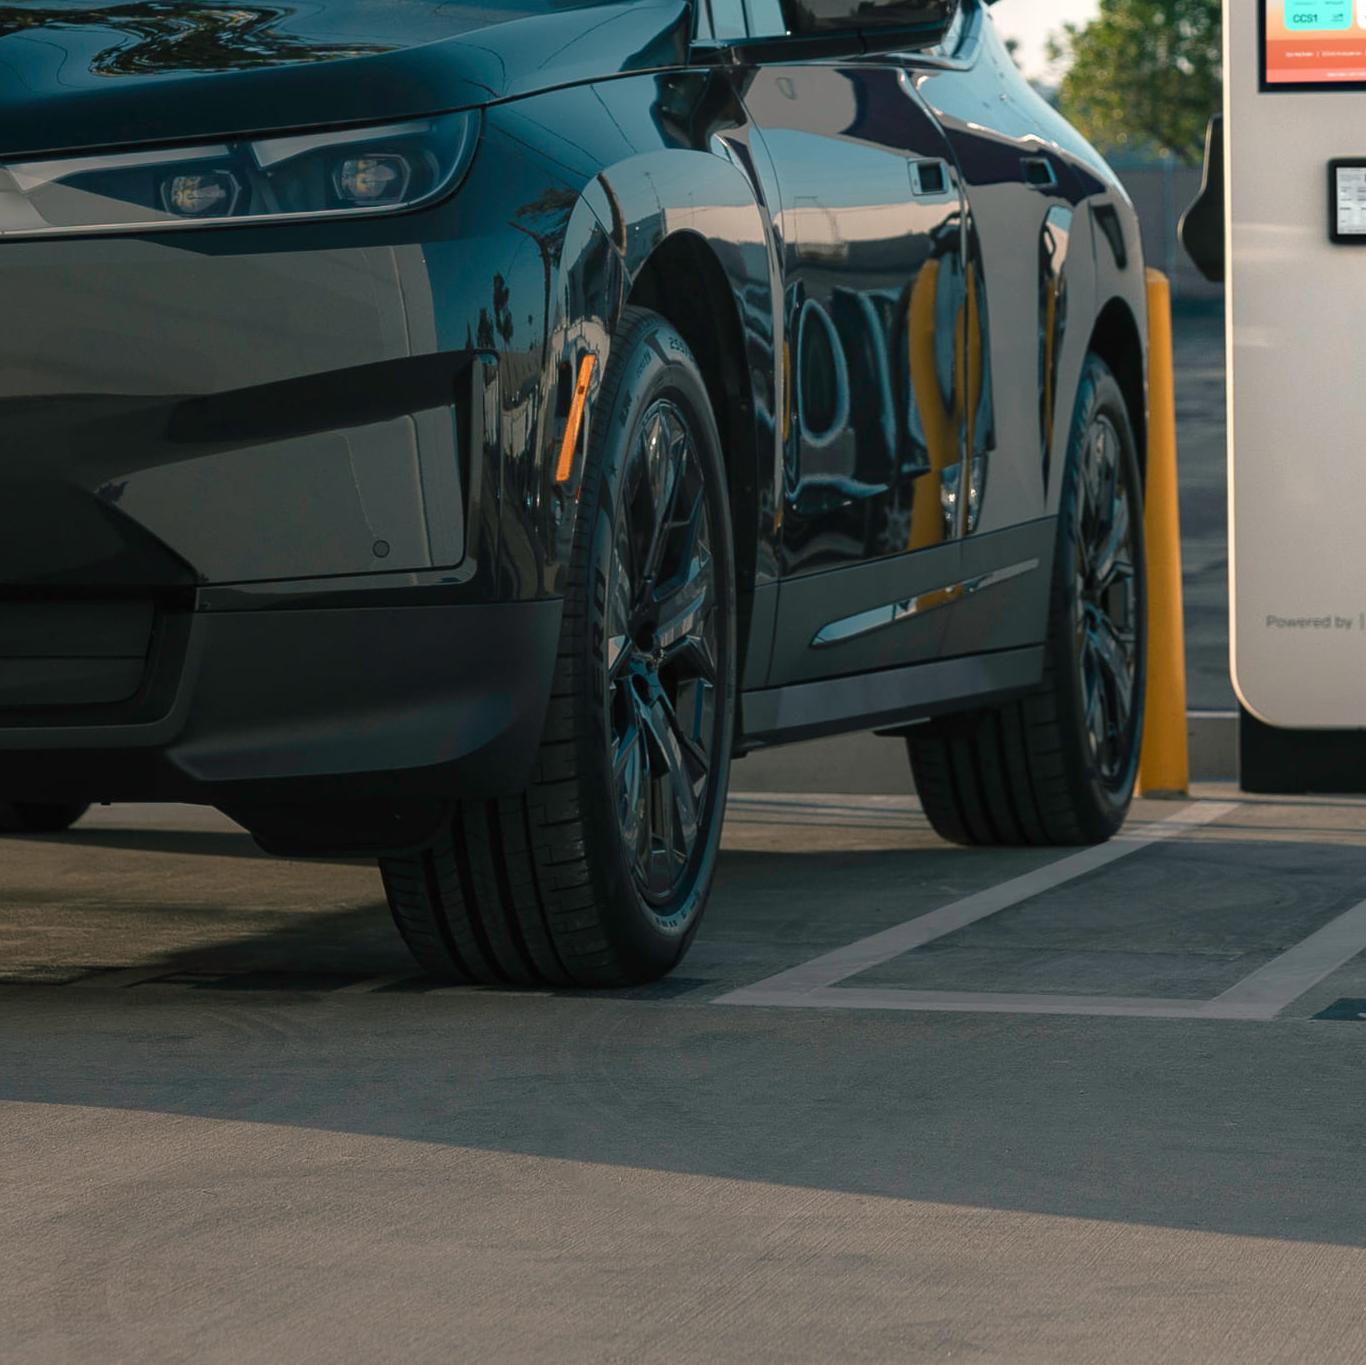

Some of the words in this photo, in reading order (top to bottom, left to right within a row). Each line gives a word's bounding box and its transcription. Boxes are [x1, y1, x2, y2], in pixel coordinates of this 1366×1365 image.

[1292, 13, 1319, 24] CCS1
[1265, 614, 1332, 629] Powered
[1334, 614, 1353, 630] by
